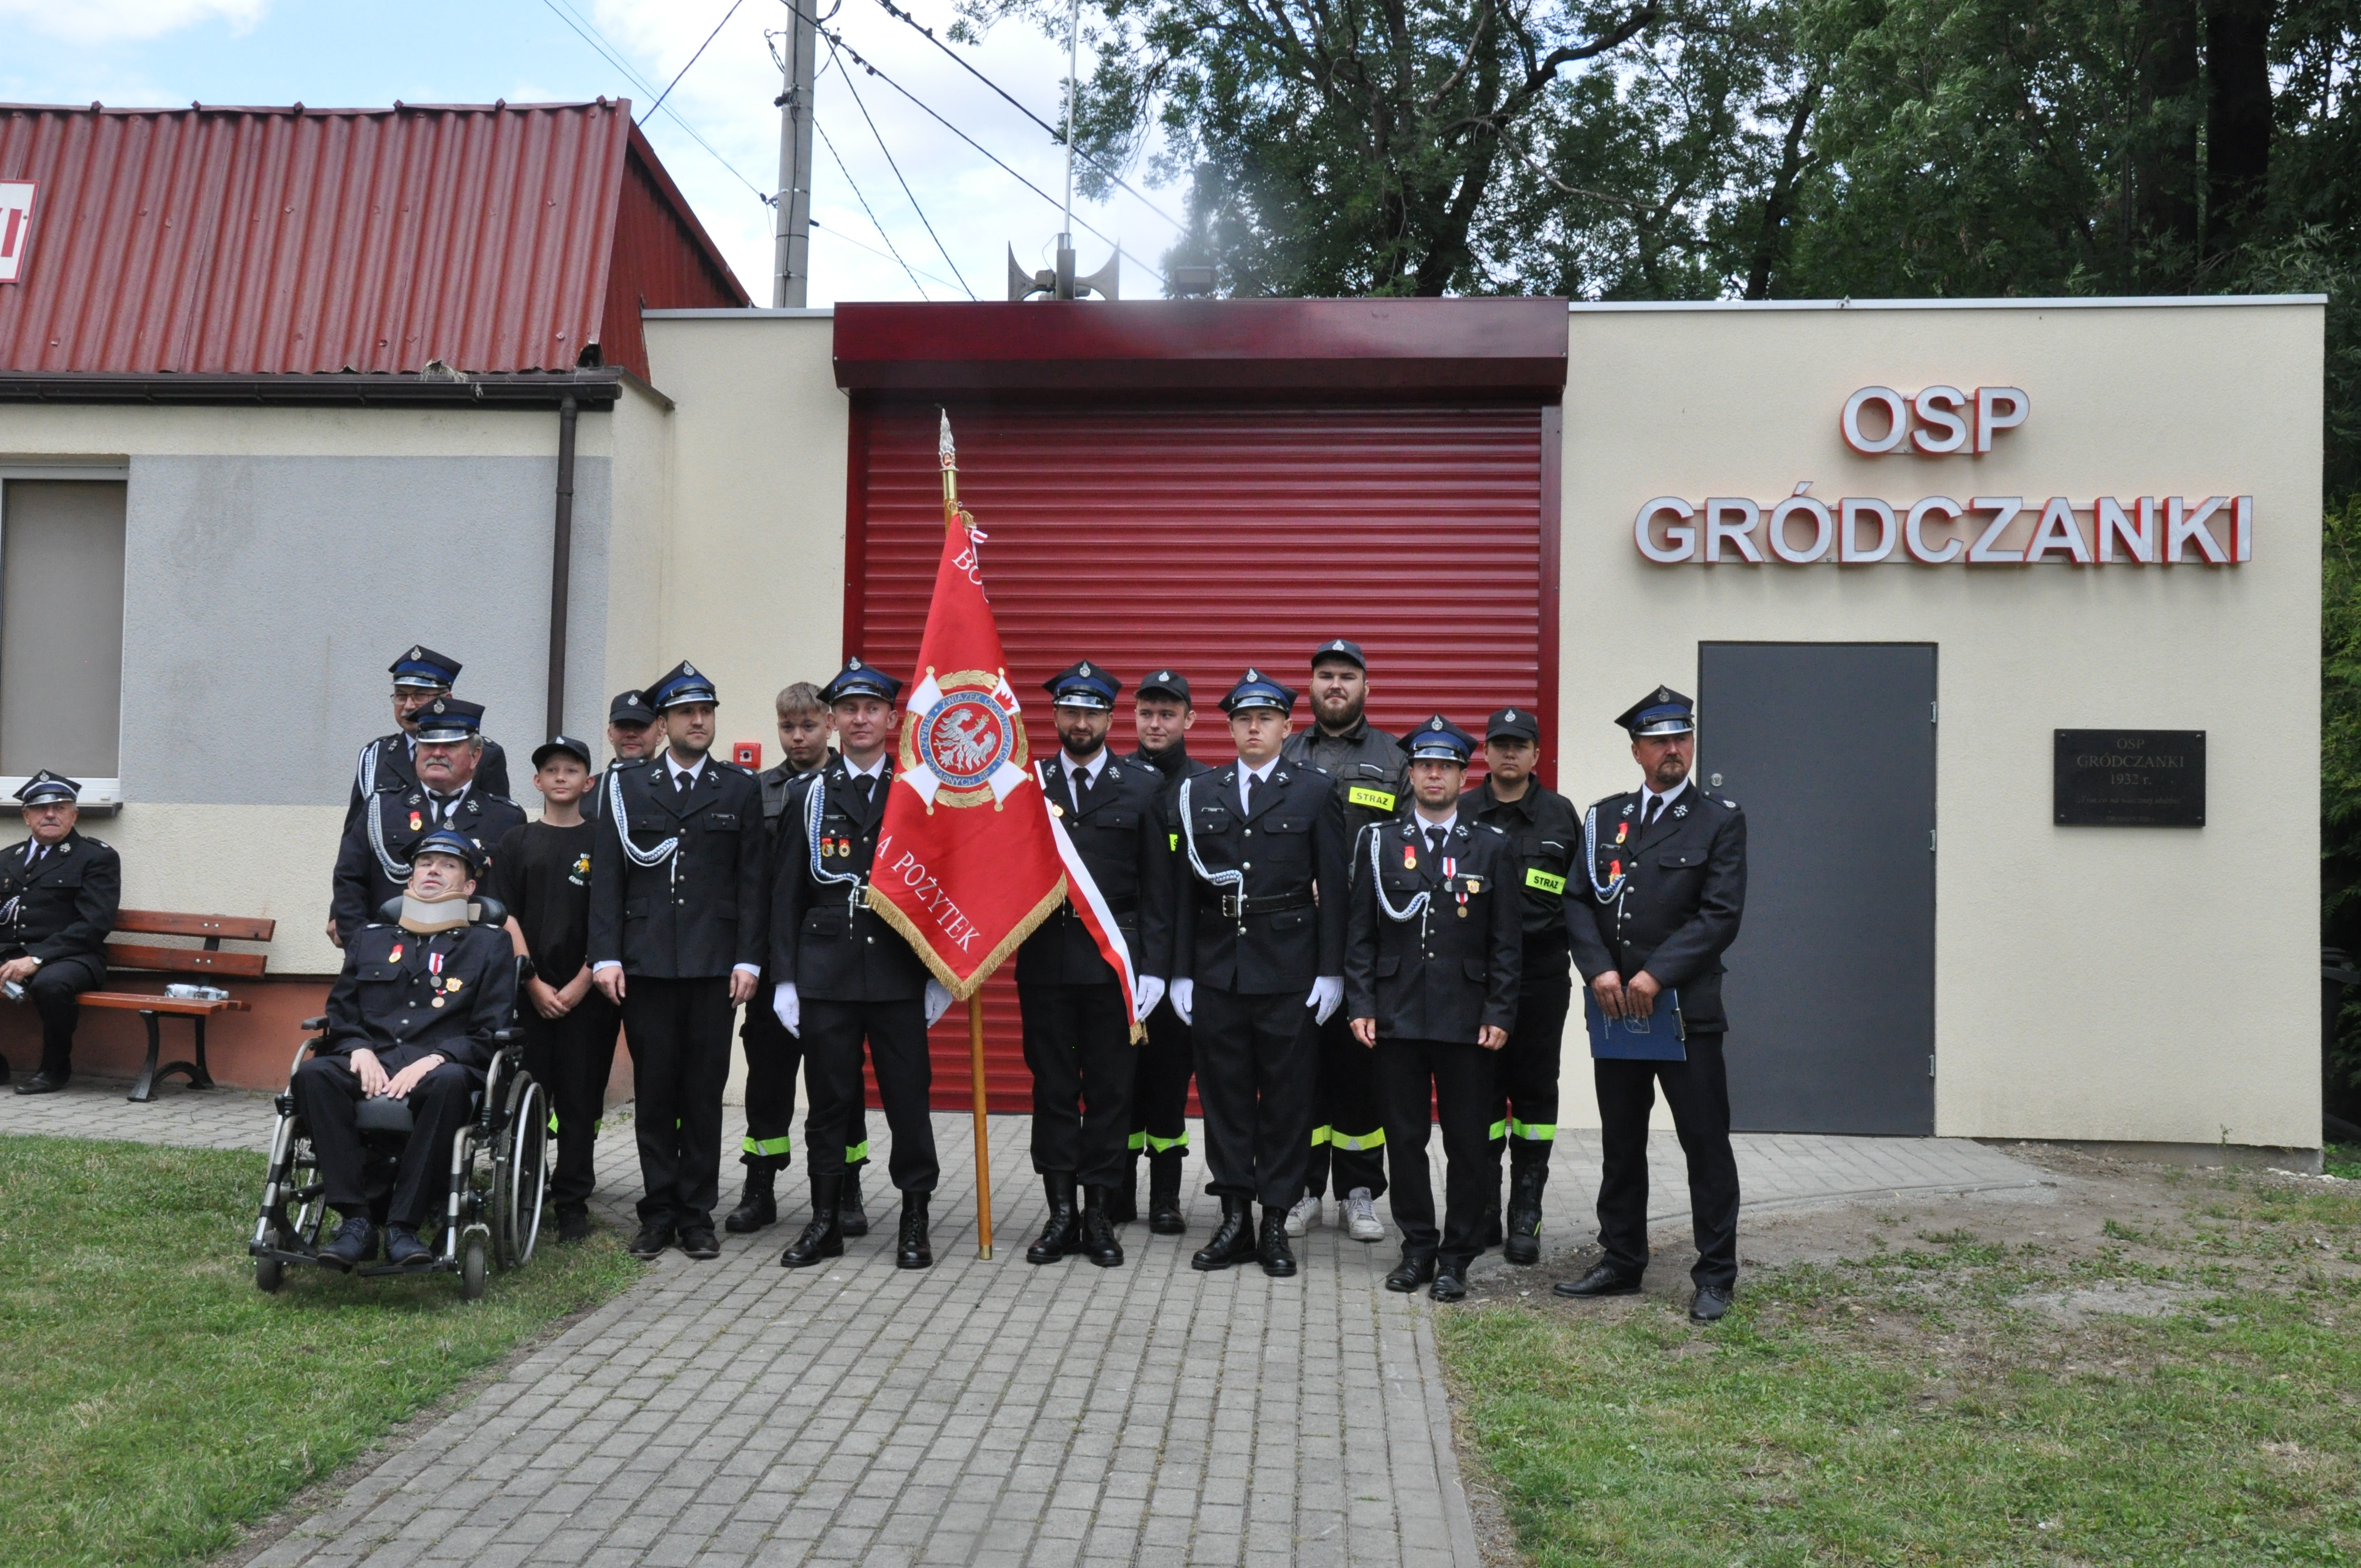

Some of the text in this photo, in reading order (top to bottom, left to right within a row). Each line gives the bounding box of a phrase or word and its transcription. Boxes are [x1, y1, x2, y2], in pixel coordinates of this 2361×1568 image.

[1840, 385, 2030, 455] OSP
[1633, 481, 2253, 564] GRÓDCZANKI
[984, 698, 1011, 764] OCHOTNICZYCH
[2117, 738, 2145, 749] OSP
[978, 770, 989, 781] RP
[2076, 752, 2184, 767] GRÓDCZANKI
[2110, 772, 2152, 785] 1932 r.
[891, 851, 981, 954] POŻYTEK
